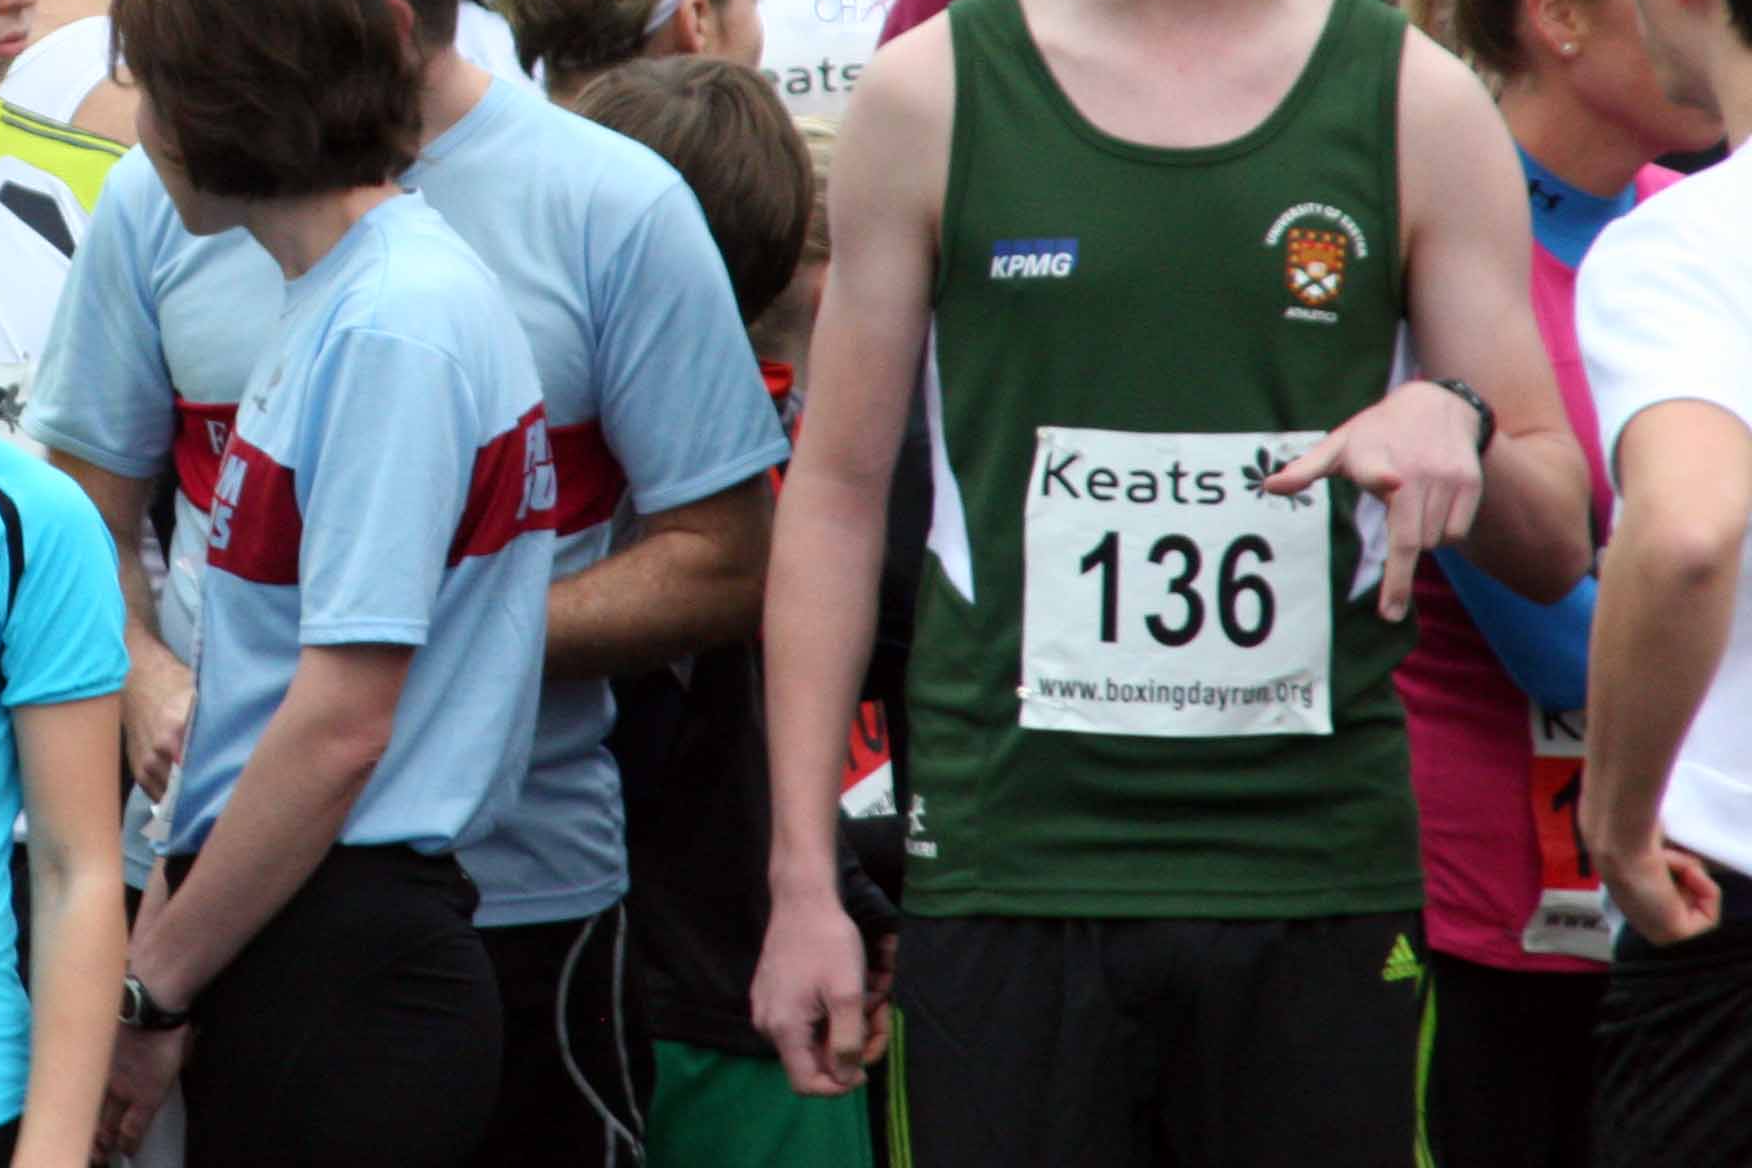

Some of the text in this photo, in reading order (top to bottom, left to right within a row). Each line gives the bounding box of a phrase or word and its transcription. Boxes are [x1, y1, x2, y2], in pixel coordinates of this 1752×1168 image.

[760, 57, 865, 95] ats
[990, 252, 1073, 279] KPMG
[1041, 451, 1226, 505] Keats
[1080, 531, 1276, 649] 136
[1037, 676, 1314, 711] www.boxingdayrun.org
